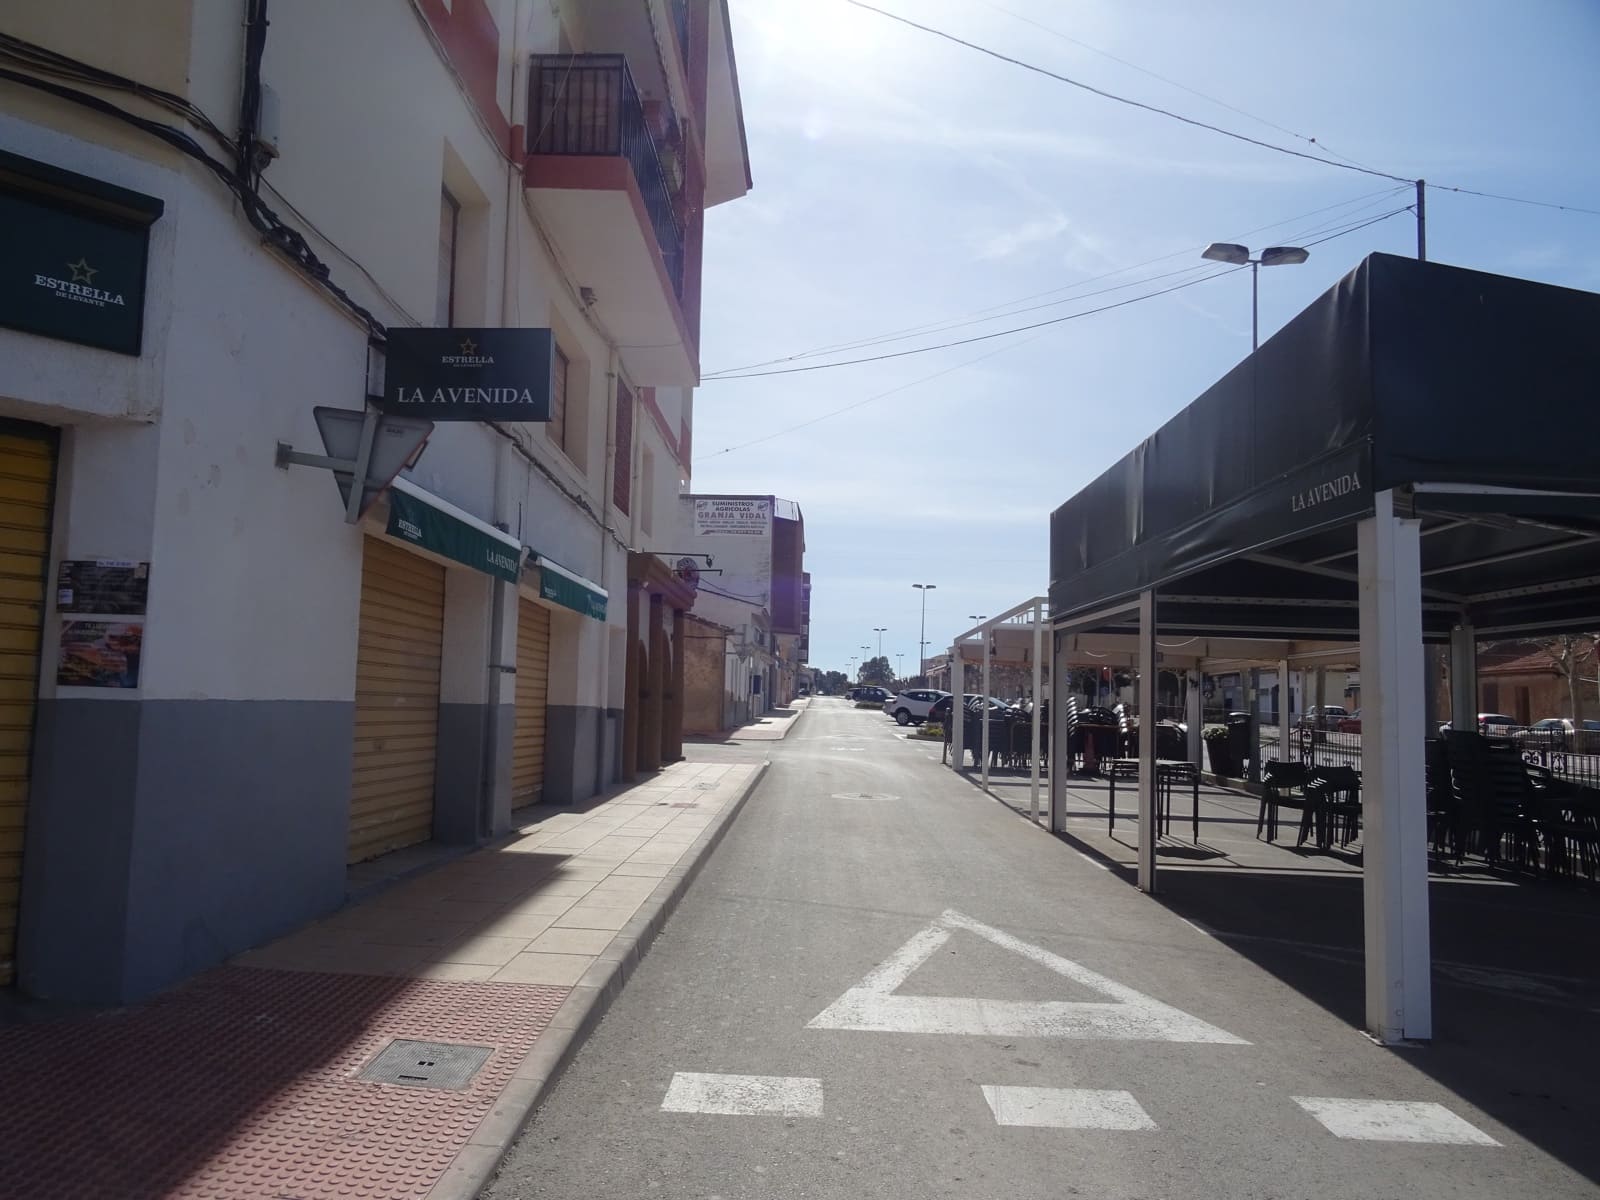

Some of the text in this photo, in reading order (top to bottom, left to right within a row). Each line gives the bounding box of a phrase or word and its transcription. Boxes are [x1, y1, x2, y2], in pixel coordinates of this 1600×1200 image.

[34, 274, 126, 306] ESTRELLA
[55, 290, 105, 307] DE LEVANTE
[441, 356, 495, 364] ESTRELLA
[397, 387, 535, 404] LA AVENIDA
[1292, 471, 1361, 512] LA AVENIDA
[398, 519, 423, 538] ESTRELLA
